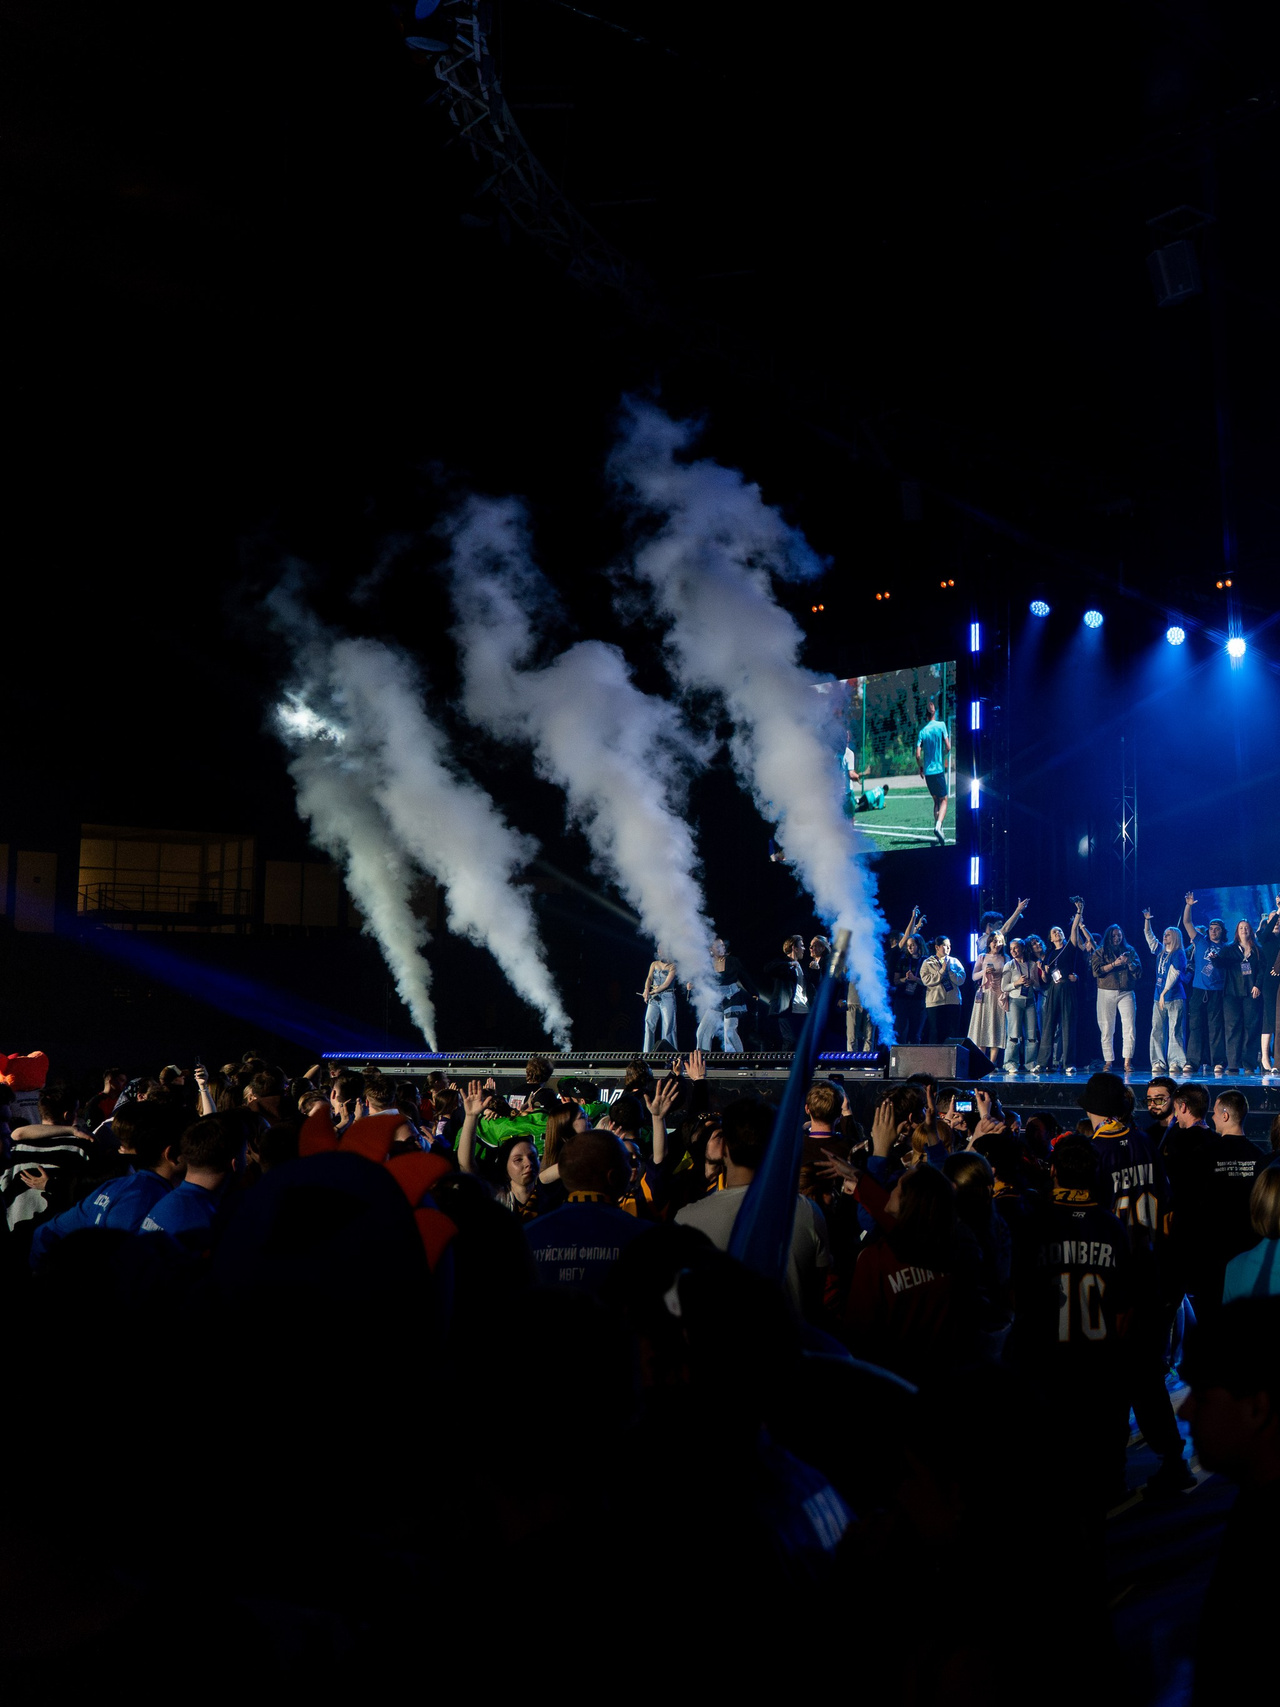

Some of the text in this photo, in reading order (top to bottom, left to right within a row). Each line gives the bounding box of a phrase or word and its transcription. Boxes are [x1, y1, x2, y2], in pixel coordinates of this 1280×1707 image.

[559, 1267, 586, 1281] ИВГУ
[887, 1266, 935, 1294] MEDIA
[1050, 1271, 1108, 1343] 10
